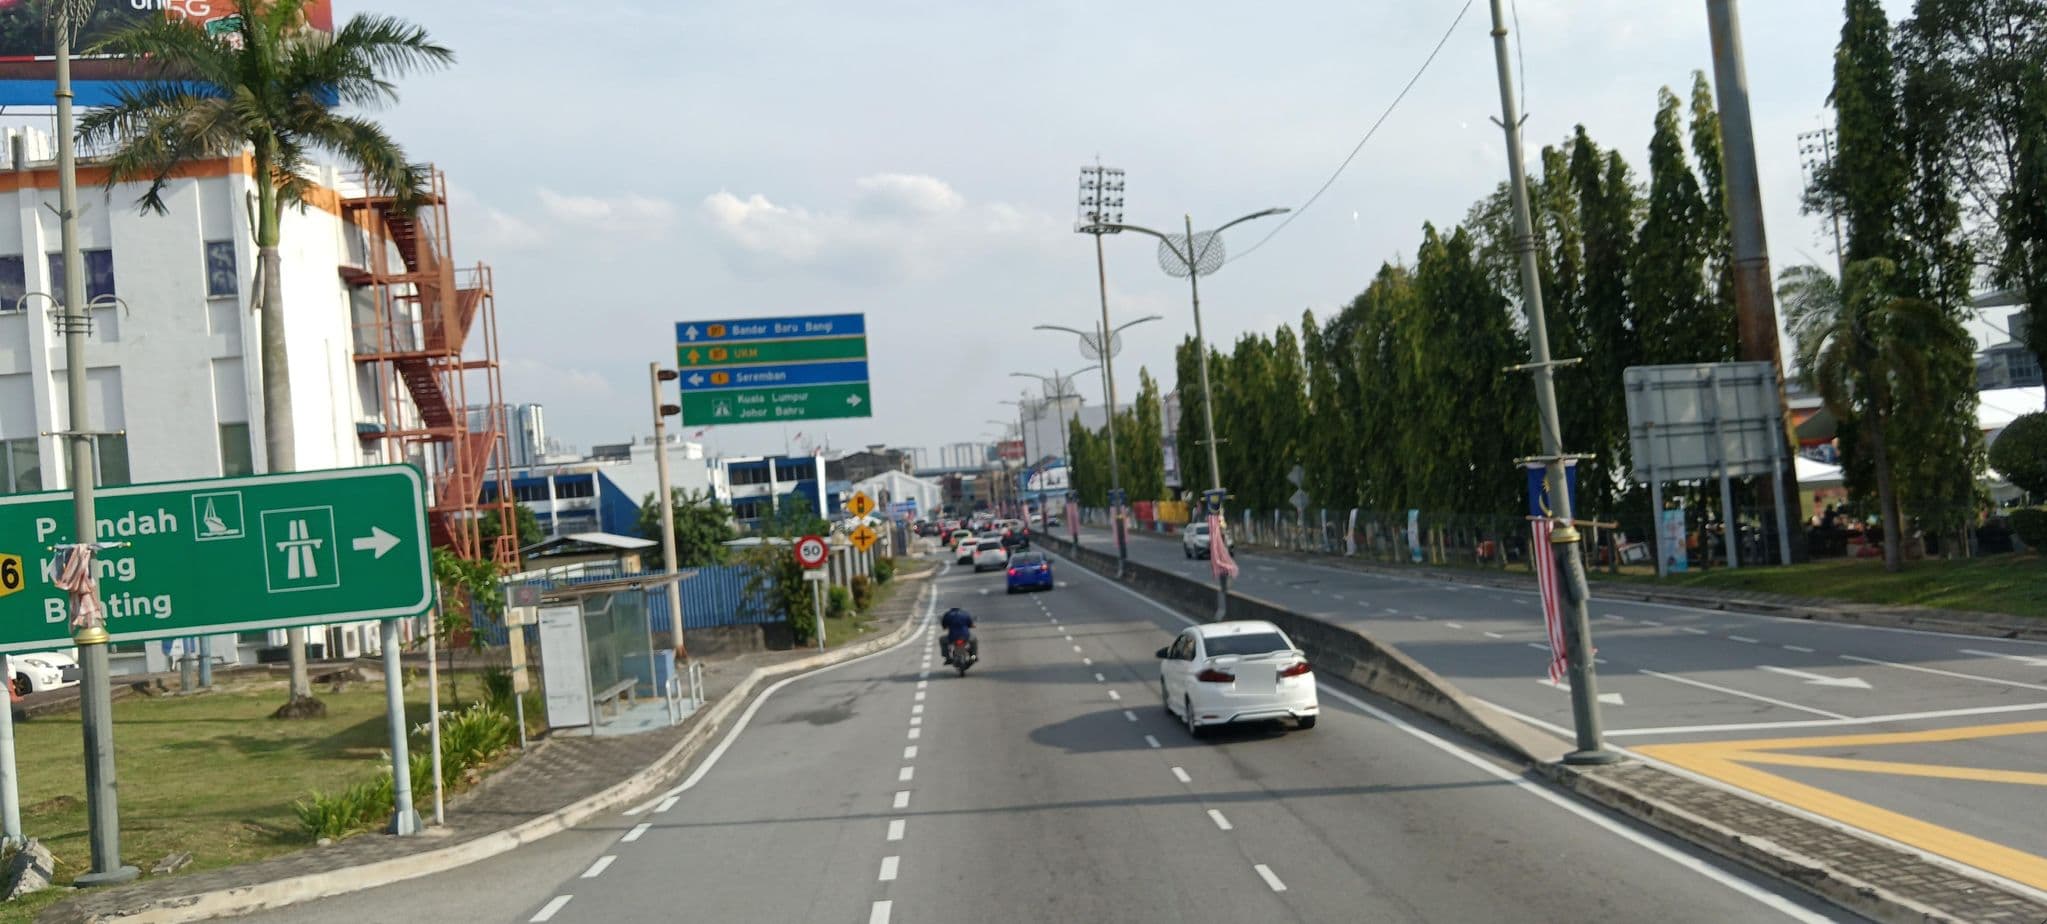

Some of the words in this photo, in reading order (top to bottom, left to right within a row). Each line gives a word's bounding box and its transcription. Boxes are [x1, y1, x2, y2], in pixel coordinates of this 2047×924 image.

[732, 324, 767, 336] Bandar
[774, 322, 799, 334] Baru
[805, 321, 833, 333] Bangi
[734, 348, 758, 359] UKM
[736, 371, 786, 383] Seremban
[737, 393, 765, 404] Kuala
[771, 392, 808, 403] Lumpur
[740, 407, 768, 418] Johor
[775, 406, 805, 417] Bahru
[97, 508, 177, 538] ndah
[803, 545, 820, 557] 50
[1, 558, 20, 590] 6
[40, 556, 136, 584] Kng
[44, 592, 172, 624] Bting
